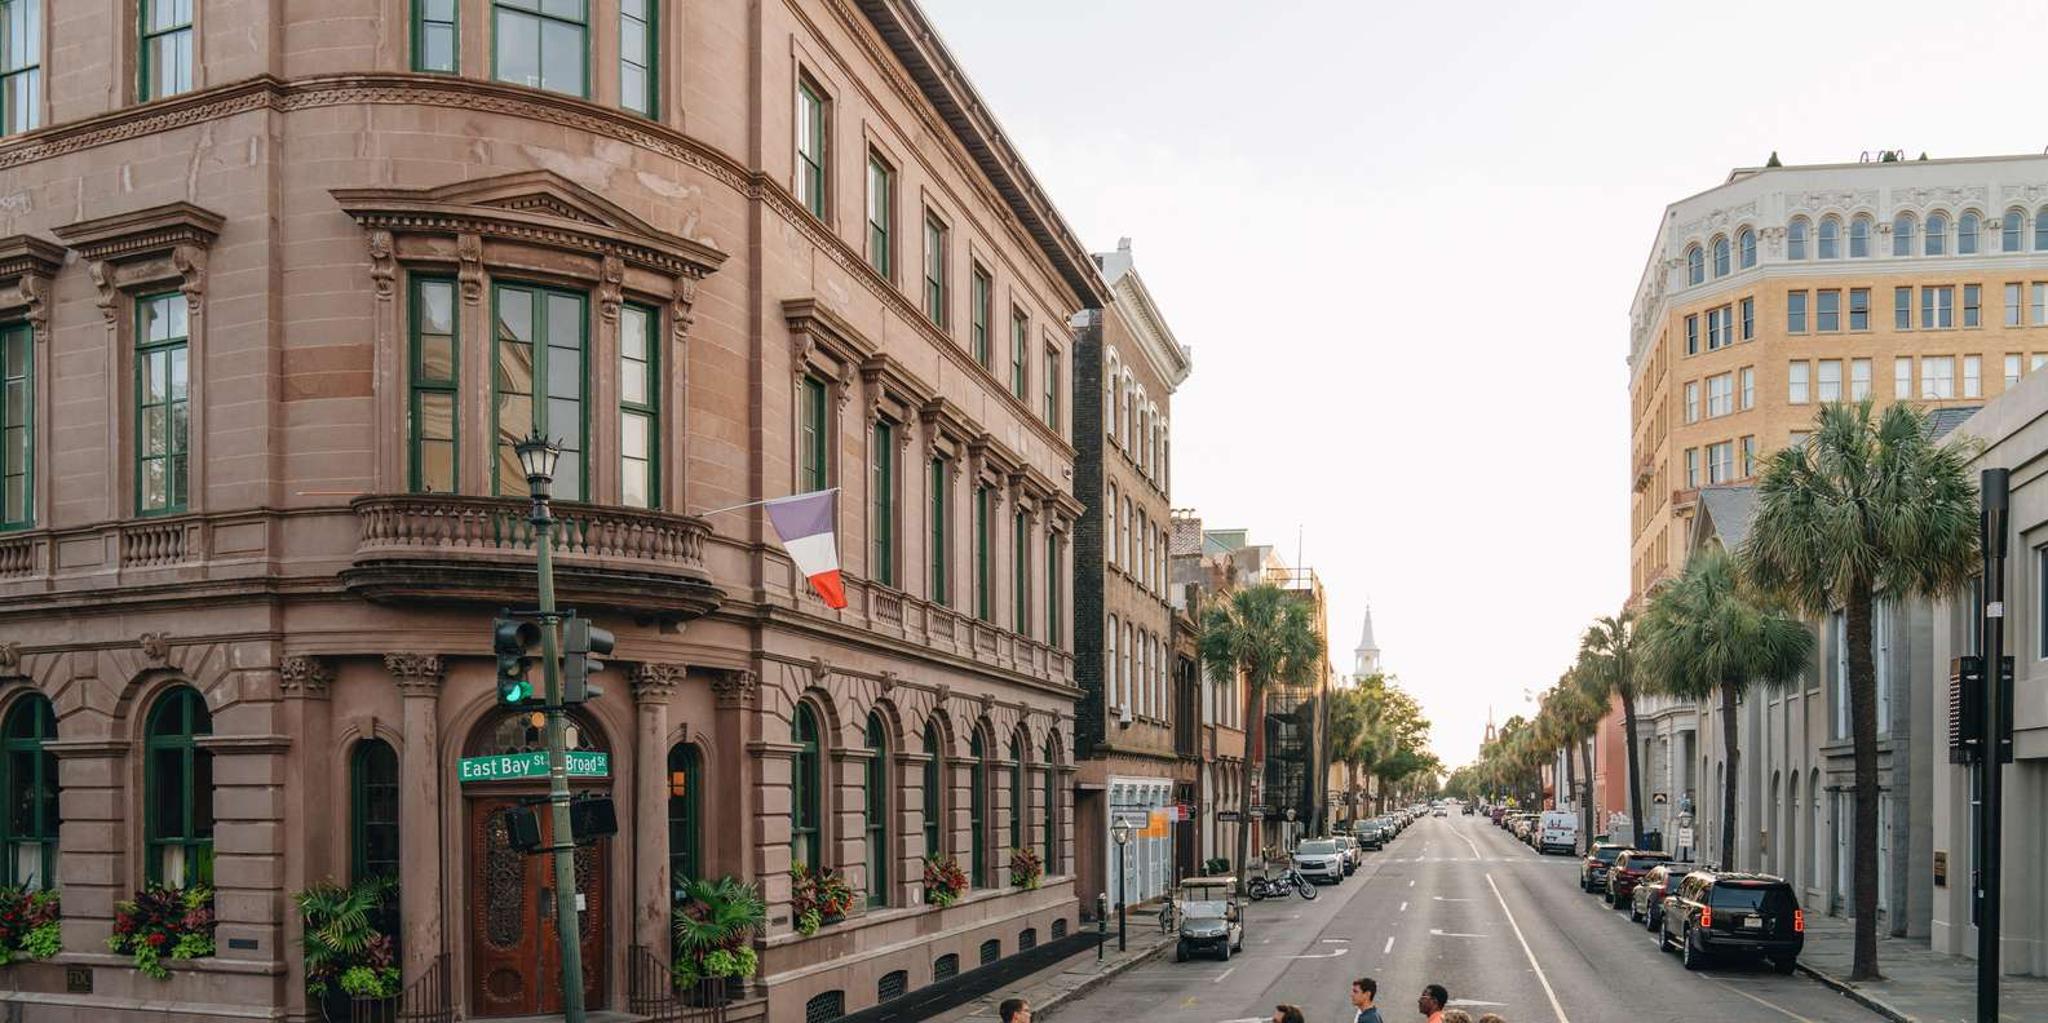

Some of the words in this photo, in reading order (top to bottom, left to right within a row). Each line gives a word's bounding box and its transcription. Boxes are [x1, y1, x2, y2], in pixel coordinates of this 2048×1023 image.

[463, 760, 497, 777] East
[502, 758, 531, 775] Bay
[533, 755, 545, 766] St
[566, 755, 597, 772] Broad
[597, 756, 606, 767] St
